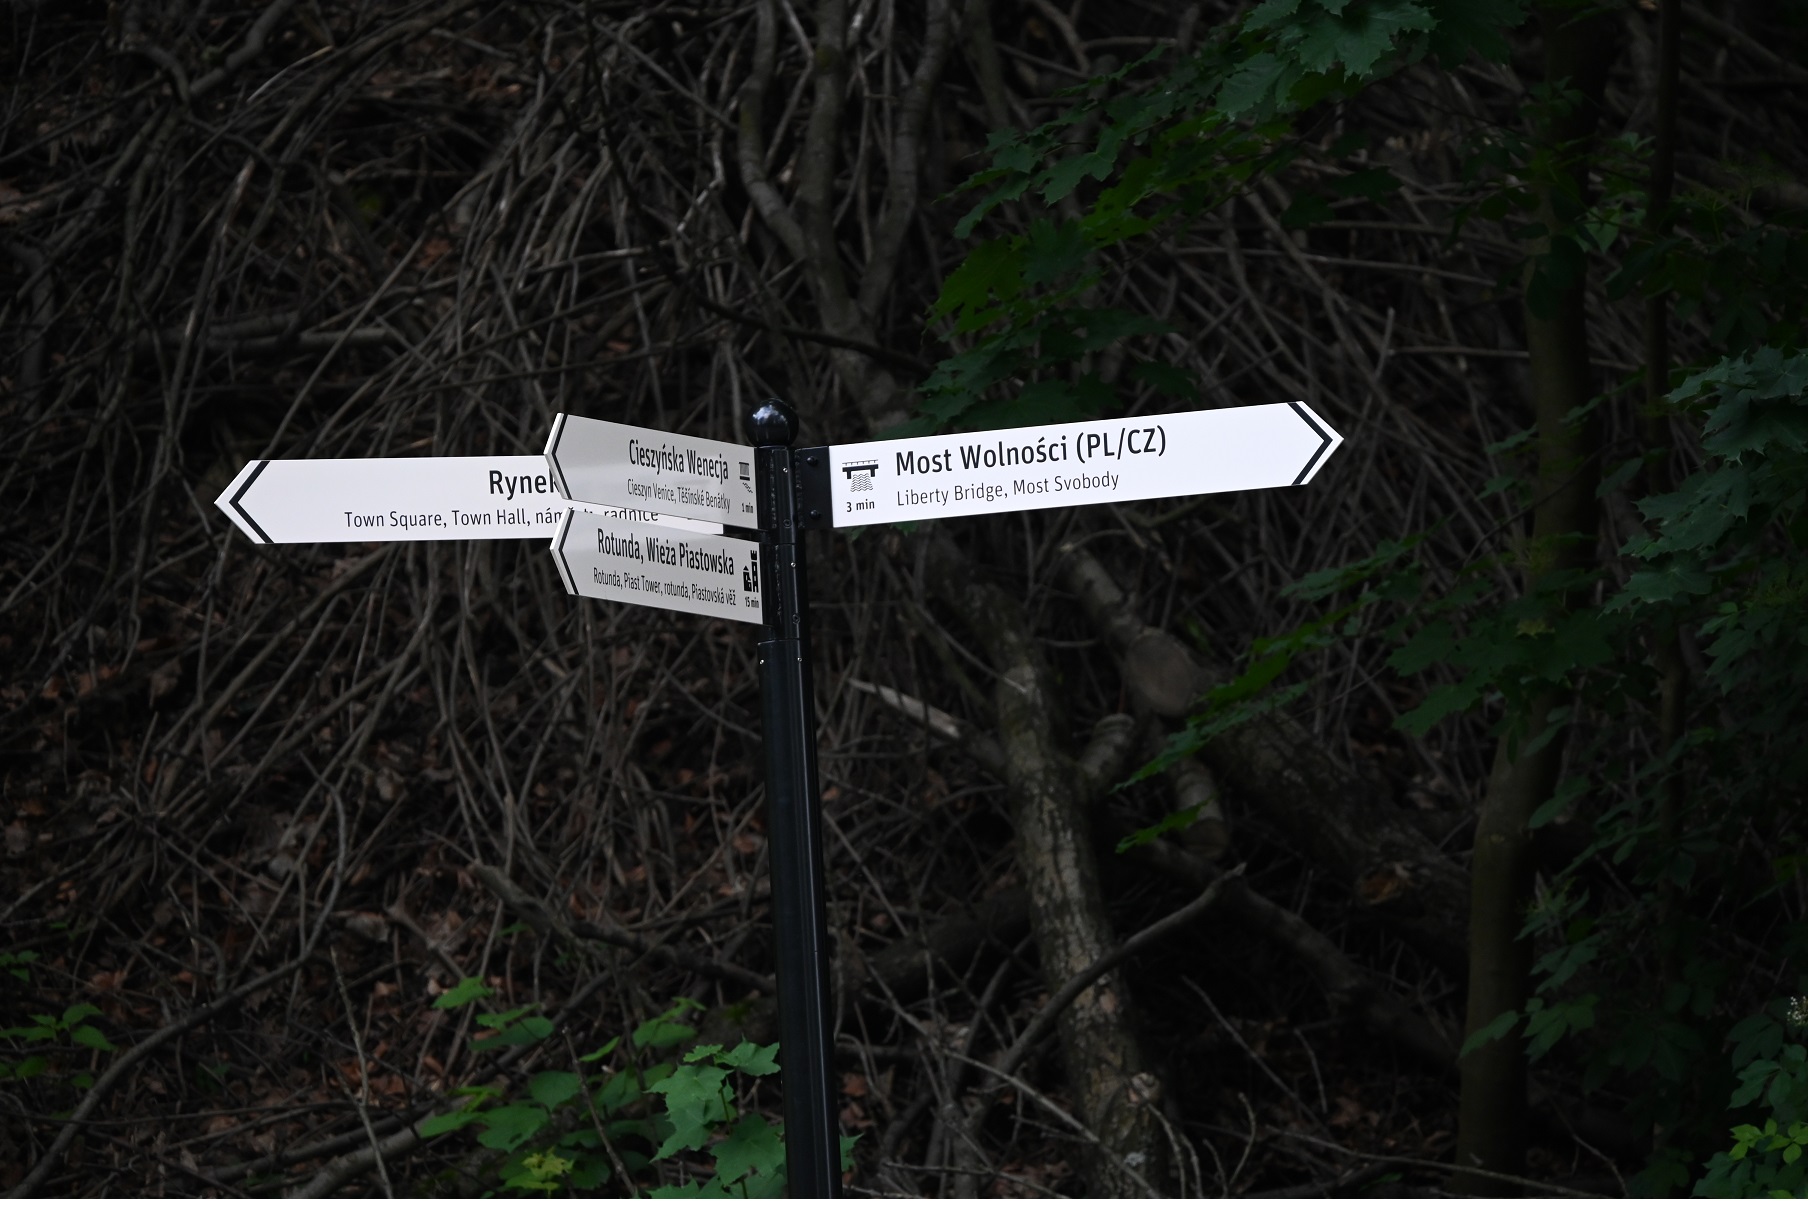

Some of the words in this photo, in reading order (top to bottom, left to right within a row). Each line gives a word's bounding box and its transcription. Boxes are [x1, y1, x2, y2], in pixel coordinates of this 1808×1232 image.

[628, 439, 685, 475] Cieszyńska
[686, 449, 729, 484] Wenecja
[896, 449, 953, 476] Most
[959, 435, 1067, 470] Wolności
[1076, 425, 1166, 464] (PL/CZ)
[488, 469, 560, 501] Rynek
[627, 478, 652, 500] Cieszyn
[653, 483, 677, 504] Venice,
[677, 486, 705, 506] Těšínské
[705, 490, 731, 513] Benátky
[897, 488, 949, 506] Liberty
[954, 482, 1008, 502] Bridge,
[1013, 478, 1050, 495] Most
[1054, 471, 1119, 492] Svobody
[344, 511, 385, 528] Town
[389, 511, 447, 530] Square,
[452, 510, 491, 526] Town
[496, 508, 531, 526] Hall,
[846, 501, 852, 513] 3
[856, 499, 875, 511] min
[597, 528, 644, 564] Rotunda,
[645, 536, 677, 566] Wieża
[679, 542, 735, 576] Piastowska
[593, 567, 623, 590] Rotunda,
[623, 572, 641, 591] Piast
[641, 575, 663, 597] Tower,
[664, 580, 691, 601] rotunda,
[691, 583, 725, 605] Piastovská
[725, 588, 737, 606] věž
